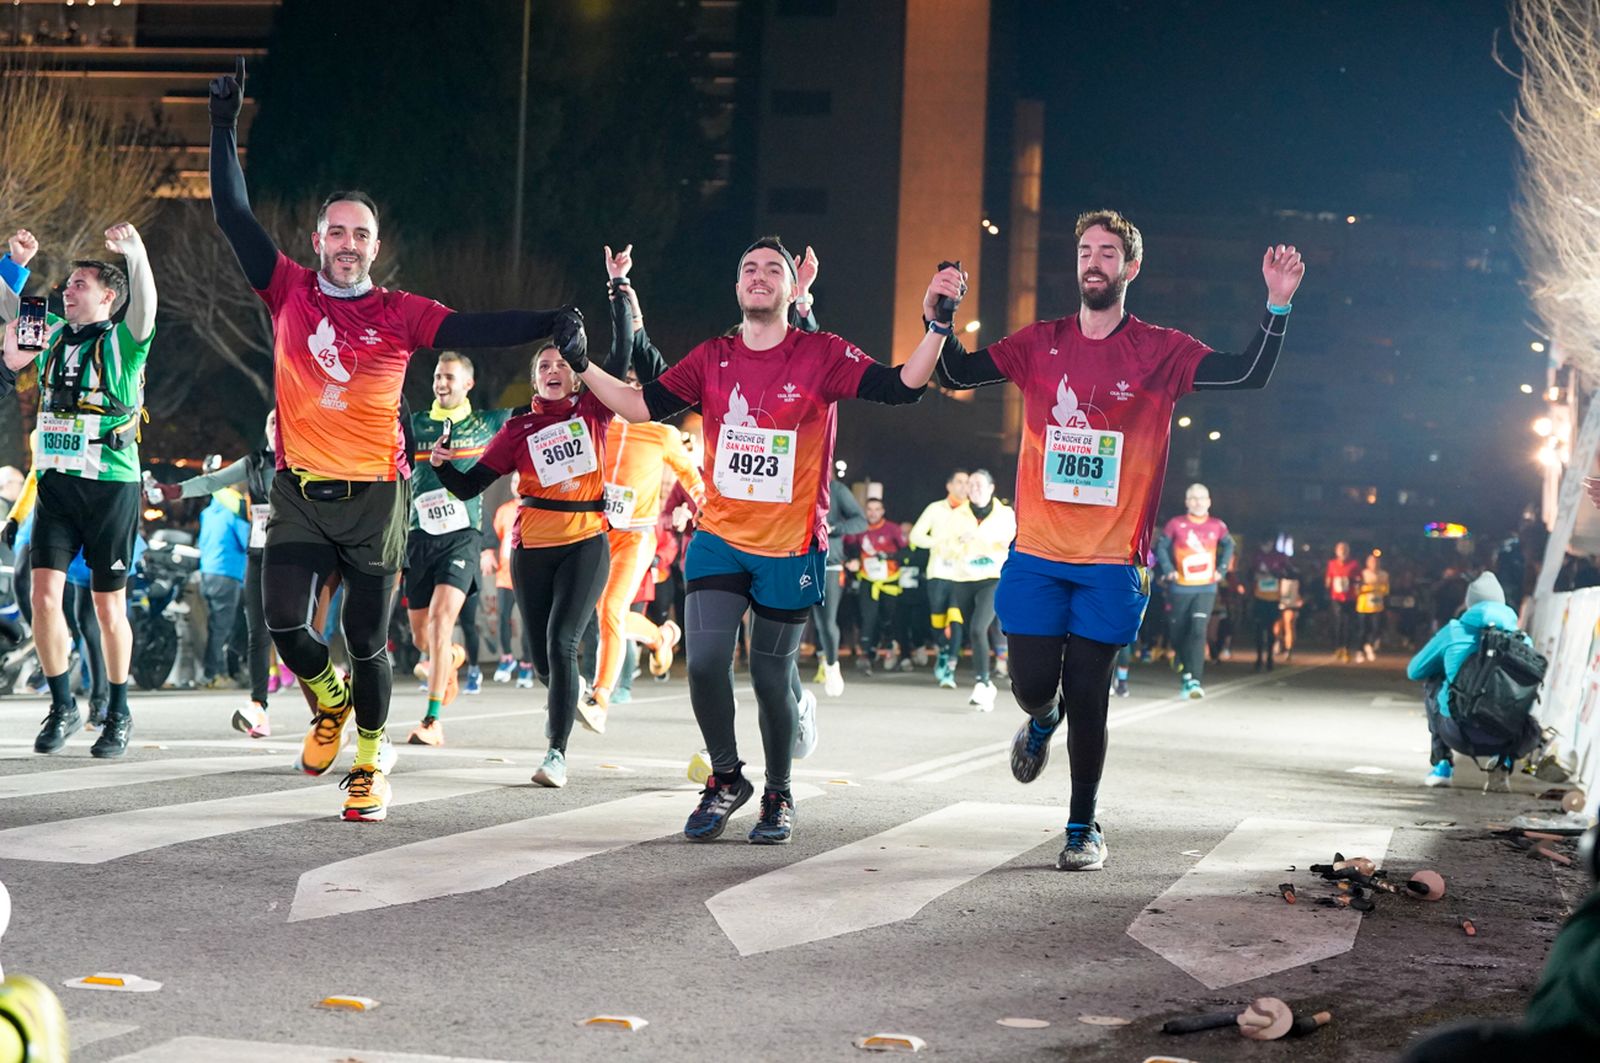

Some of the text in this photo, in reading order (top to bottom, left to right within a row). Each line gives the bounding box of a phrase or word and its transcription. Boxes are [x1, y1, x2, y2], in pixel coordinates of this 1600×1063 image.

[318, 348, 336, 368] 43
[43, 432, 80, 450] 13668
[726, 442, 739, 450] SAN
[734, 434, 755, 443] NOCHE
[757, 436, 765, 444] DE
[1053, 443, 1066, 451] SAN
[1062, 435, 1081, 444] NOCHE
[1083, 437, 1092, 445] DE
[542, 439, 583, 465] 3602
[728, 452, 779, 477] 4923
[1057, 453, 1104, 479] 7863
[427, 502, 455, 520] 4913
